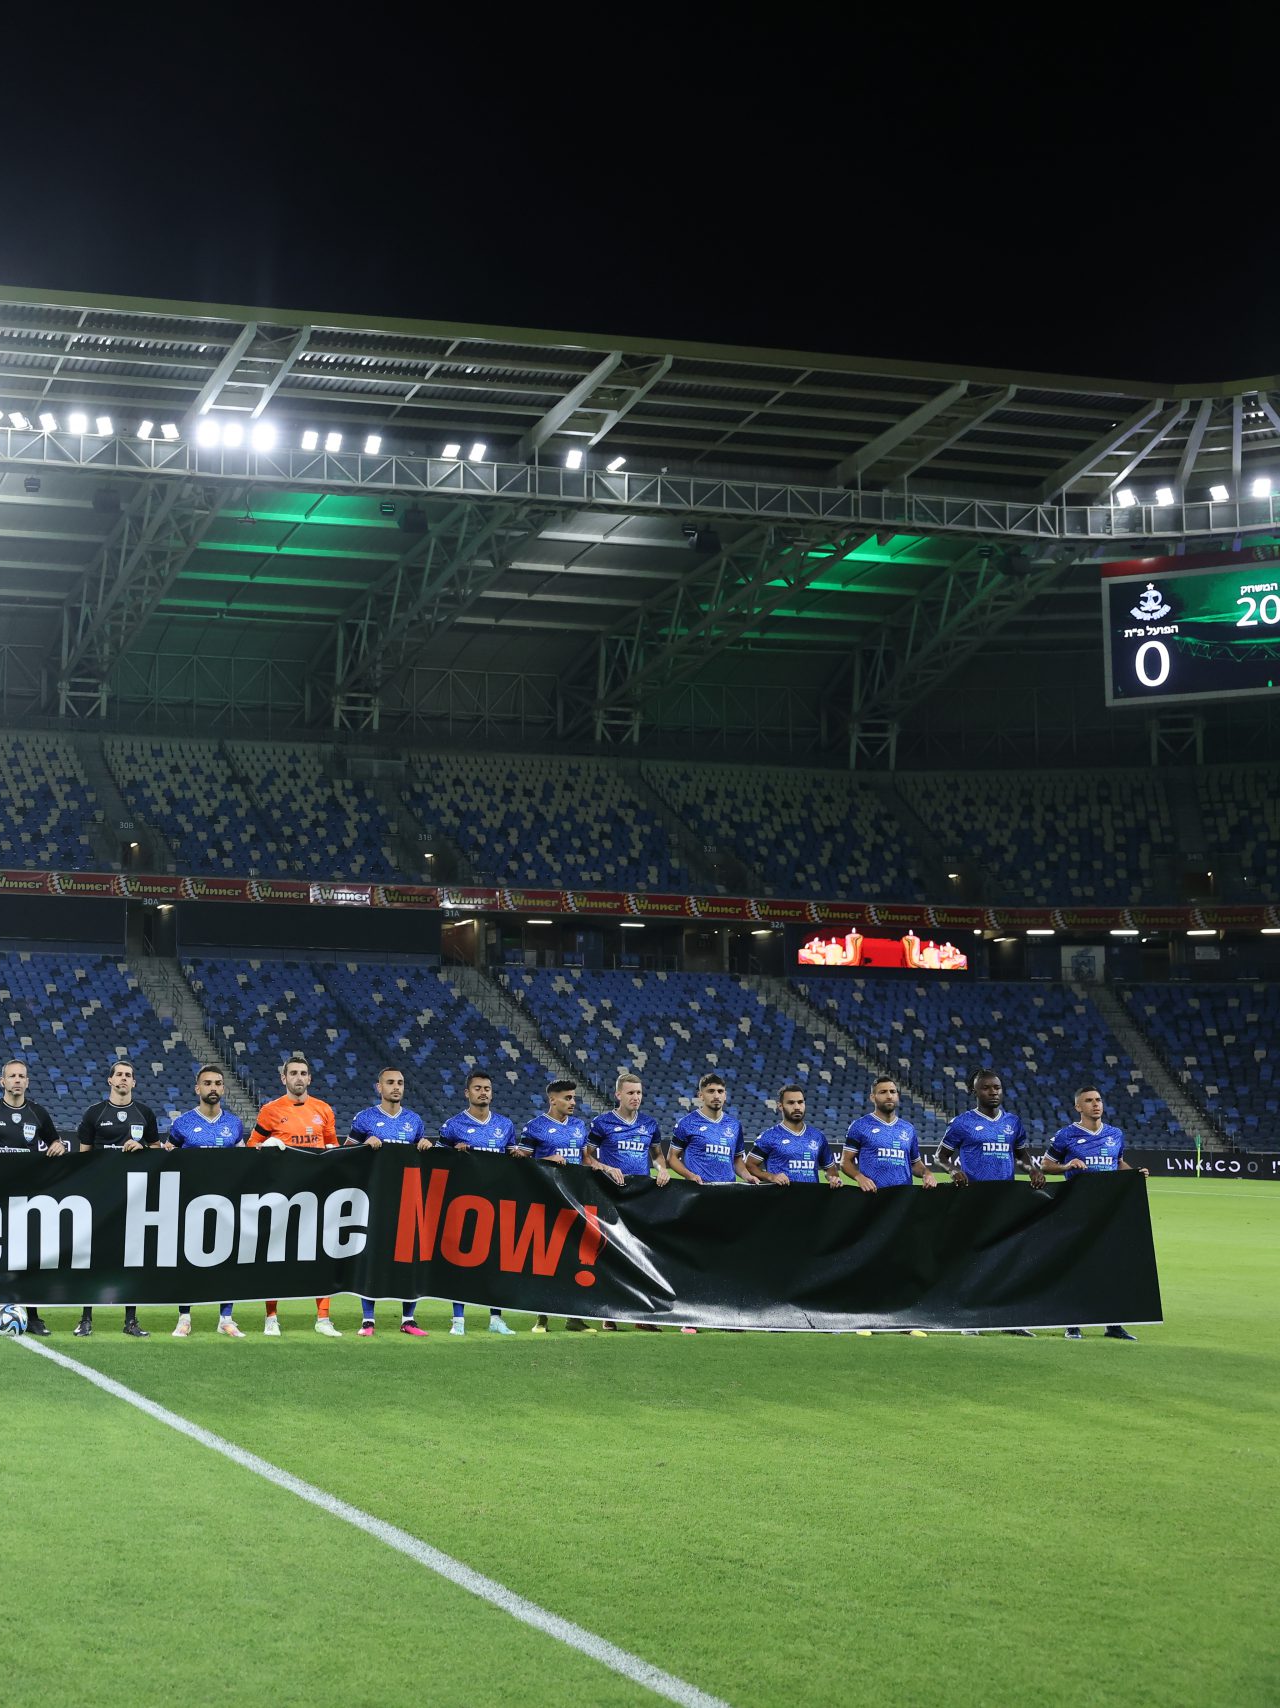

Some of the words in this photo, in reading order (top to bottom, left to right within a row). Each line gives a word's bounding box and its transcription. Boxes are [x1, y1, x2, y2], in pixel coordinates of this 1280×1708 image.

[1146, 624, 1179, 636] הפועל
[1135, 640, 1170, 687] 0
[60, 877, 109, 891] Winner
[127, 879, 176, 893] Winner
[193, 883, 242, 896] Winner
[258, 886, 306, 899] Winner
[321, 888, 369, 902] Winner
[386, 891, 433, 904] Winner
[445, 910, 460, 918] 31A
[618, 1141, 645, 1151] מבנה
[706, 1144, 731, 1155] מבנה
[983, 1142, 1010, 1152] מבנה
[878, 1148, 905, 1158] מבנה
[789, 1160, 815, 1169] מבנה
[1085, 1156, 1113, 1166] מבנה
[124, 1171, 369, 1268] Home
[394, 1166, 607, 1288] Now!
